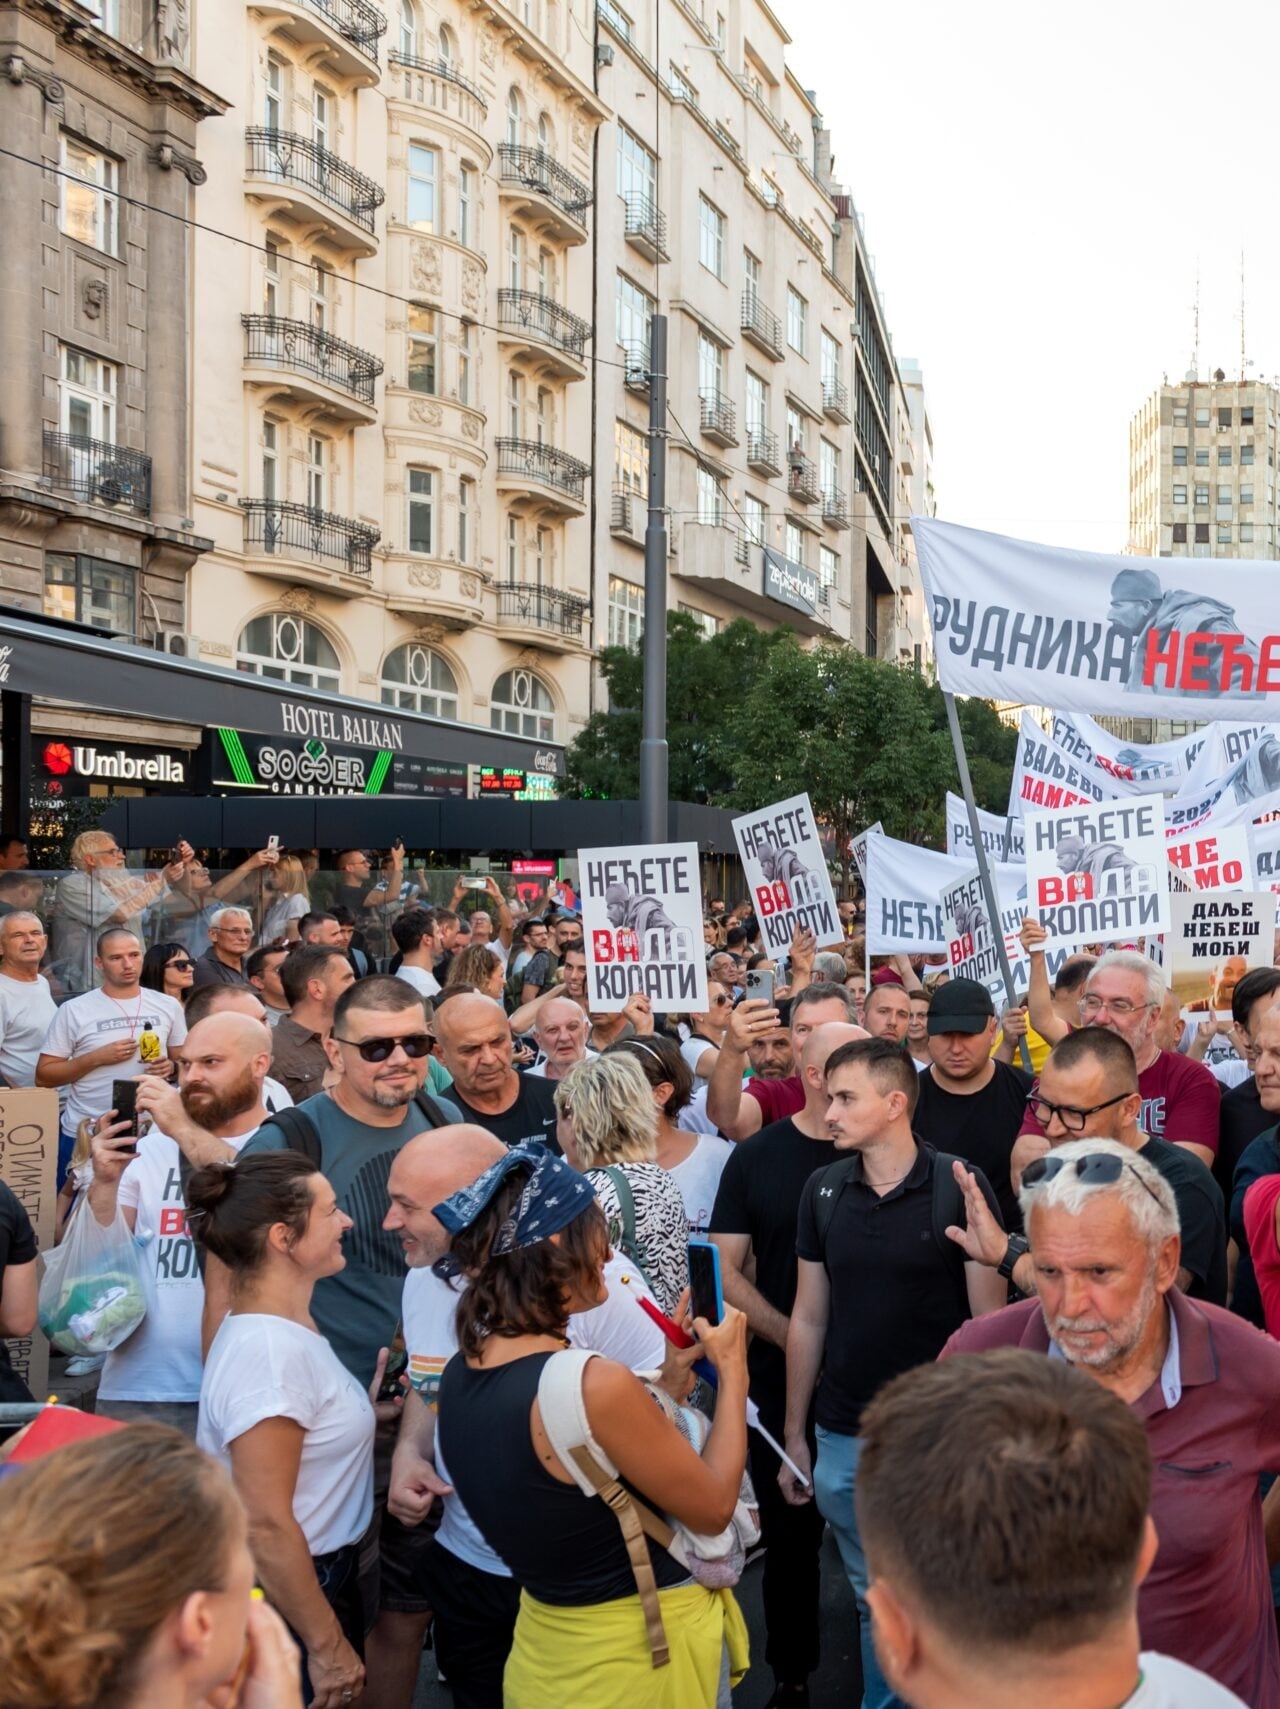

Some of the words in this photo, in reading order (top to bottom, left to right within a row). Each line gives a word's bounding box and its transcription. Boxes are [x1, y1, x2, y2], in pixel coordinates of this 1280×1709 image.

[932, 594, 1140, 684] РУДНИКА
[280, 702, 340, 740] HOTEL
[342, 715, 403, 750] BALKAN
[73, 746, 185, 783] Umbrella
[258, 746, 366, 788] SOCCER
[271, 782, 355, 797] GAMBLING
[1035, 806, 1155, 851] НЕЋЕТЕ
[1167, 837, 1219, 870] НЕ
[587, 856, 690, 897] НЕЋЕТЕ
[1194, 860, 1243, 890] МО
[1038, 893, 1160, 937] КОПАТИ
[1183, 921, 1260, 938] НЕЋЕШ
[1192, 902, 1253, 921] ДАЉЕ
[1192, 940, 1250, 957] МОЋИ
[595, 963, 698, 1000] КОПАТИ
